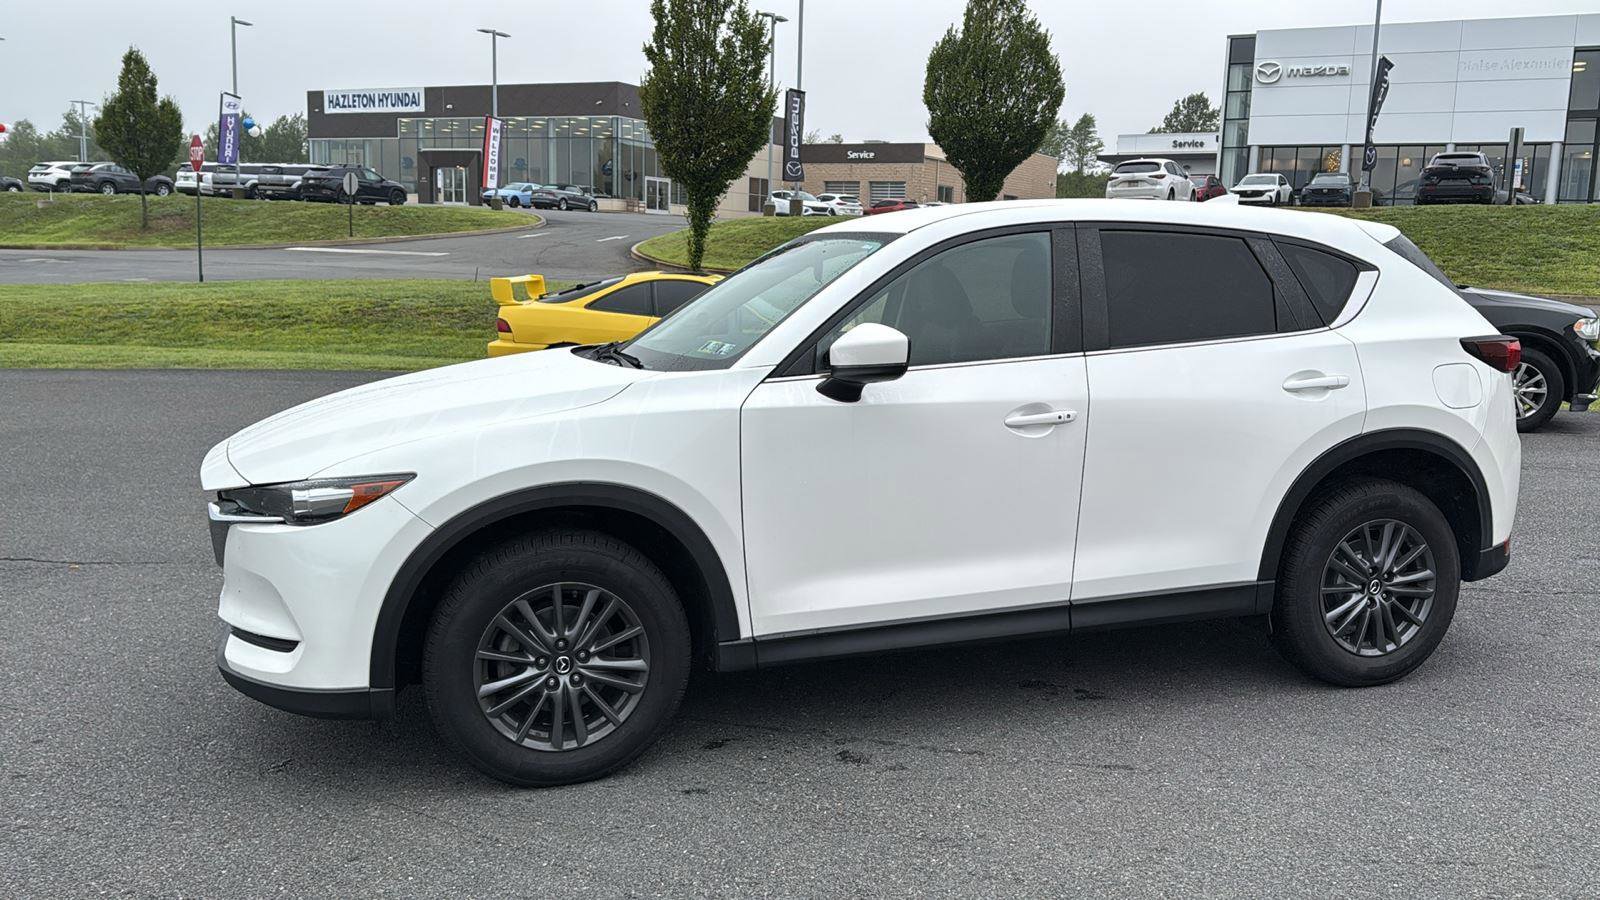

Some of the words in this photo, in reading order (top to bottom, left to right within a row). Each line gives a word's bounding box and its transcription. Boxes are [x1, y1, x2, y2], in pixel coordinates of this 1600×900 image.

[328, 93, 375, 108] HAZLETON
[378, 92, 420, 107] HYUNDAI
[225, 116, 235, 162] HYUNDAI
[1172, 139, 1205, 149] Service
[190, 146, 203, 160] STOP
[489, 127, 499, 180] WELCOME
[847, 150, 875, 159] Service
